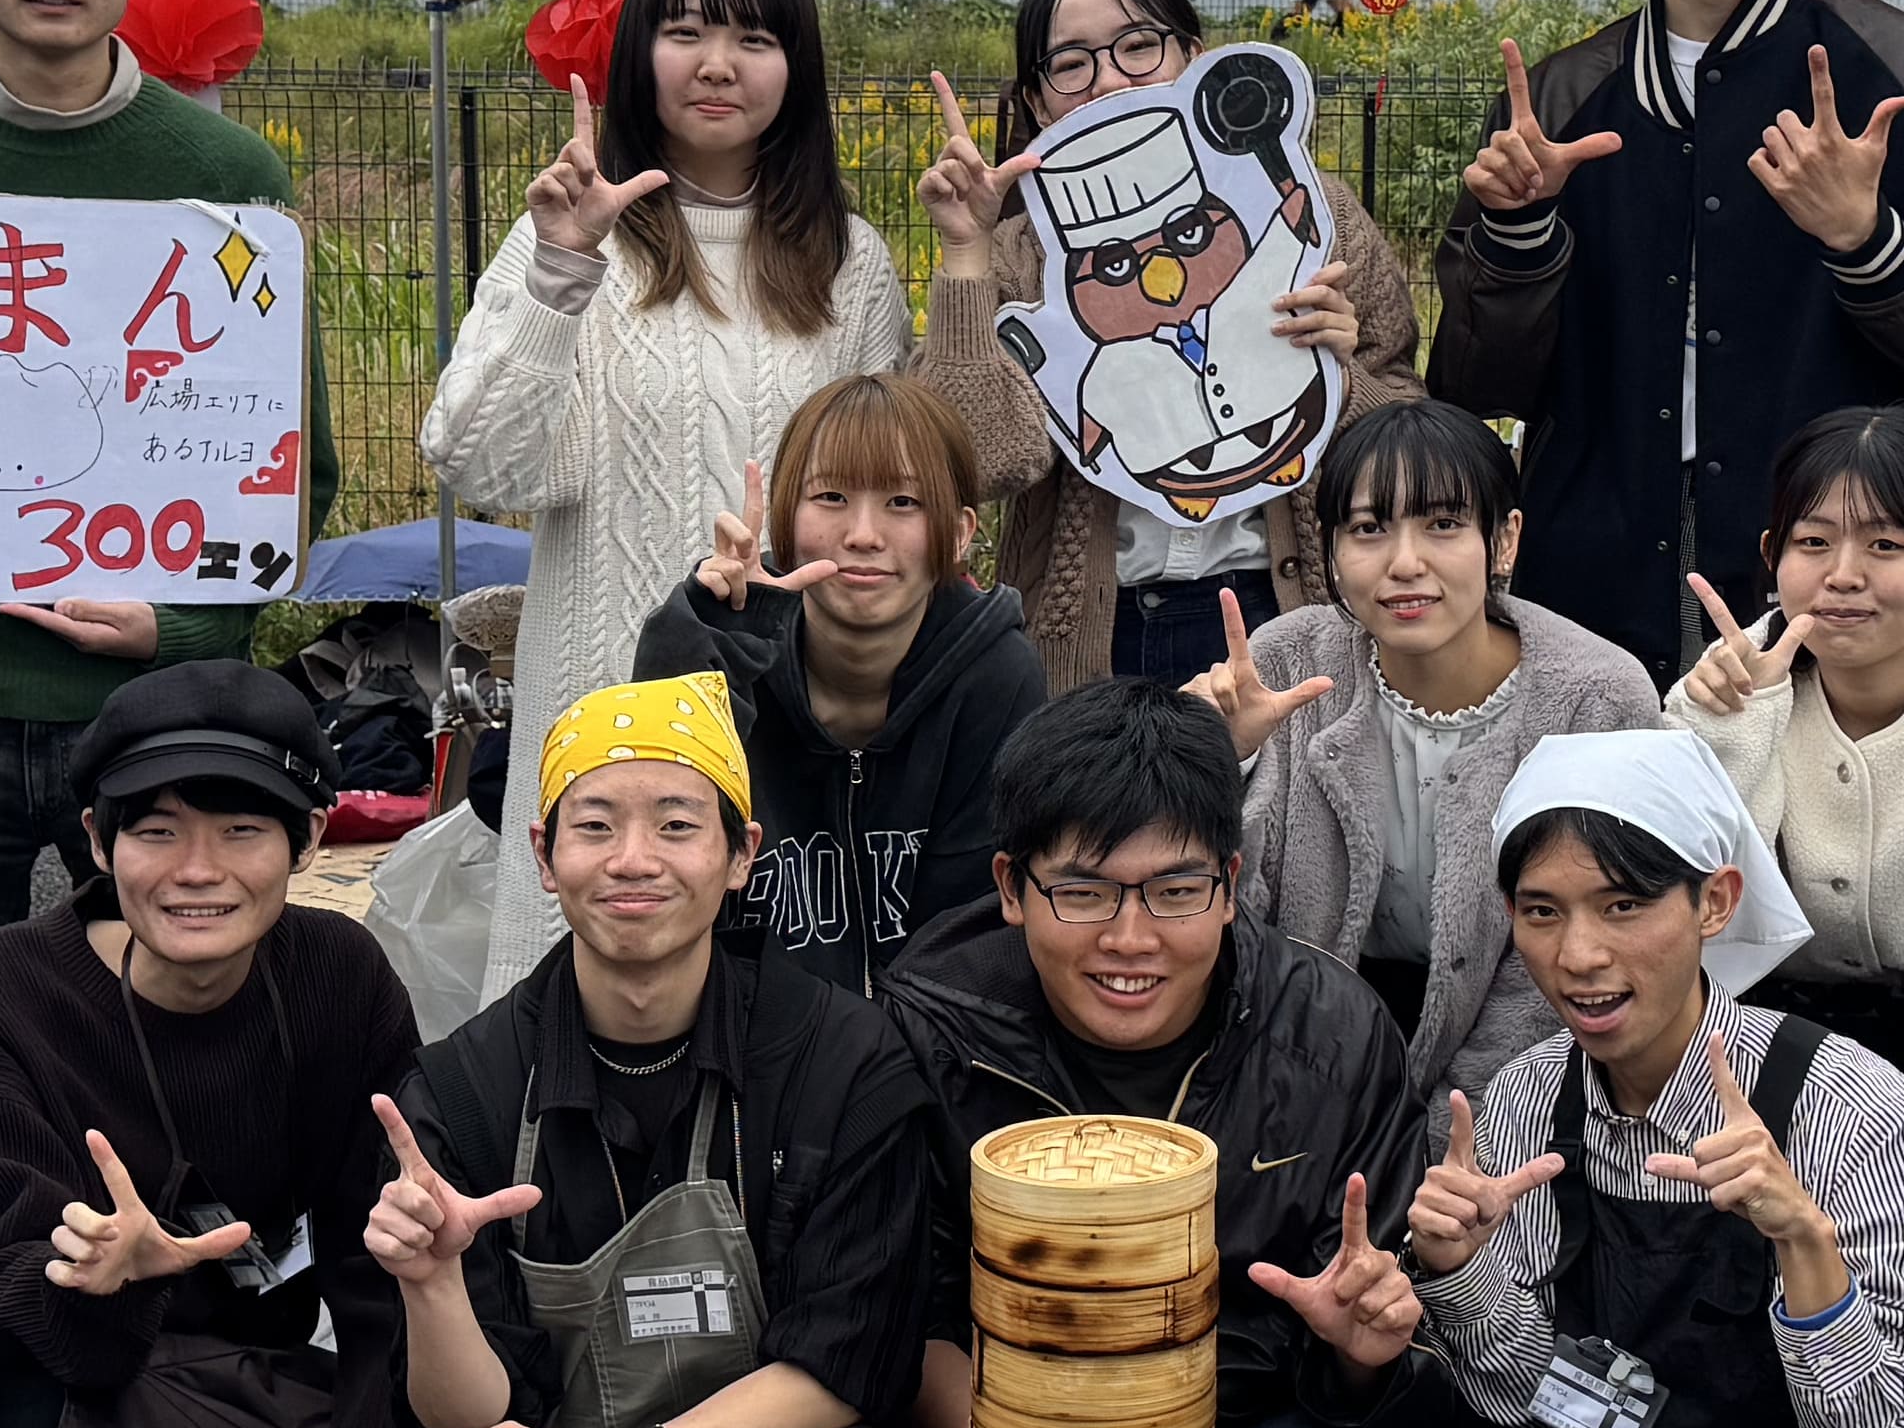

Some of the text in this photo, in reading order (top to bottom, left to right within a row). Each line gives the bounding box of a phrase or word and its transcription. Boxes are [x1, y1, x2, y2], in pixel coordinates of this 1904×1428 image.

[138, 377, 284, 414] 広場エリアに
[142, 435, 256, 465] あるアルヨ
